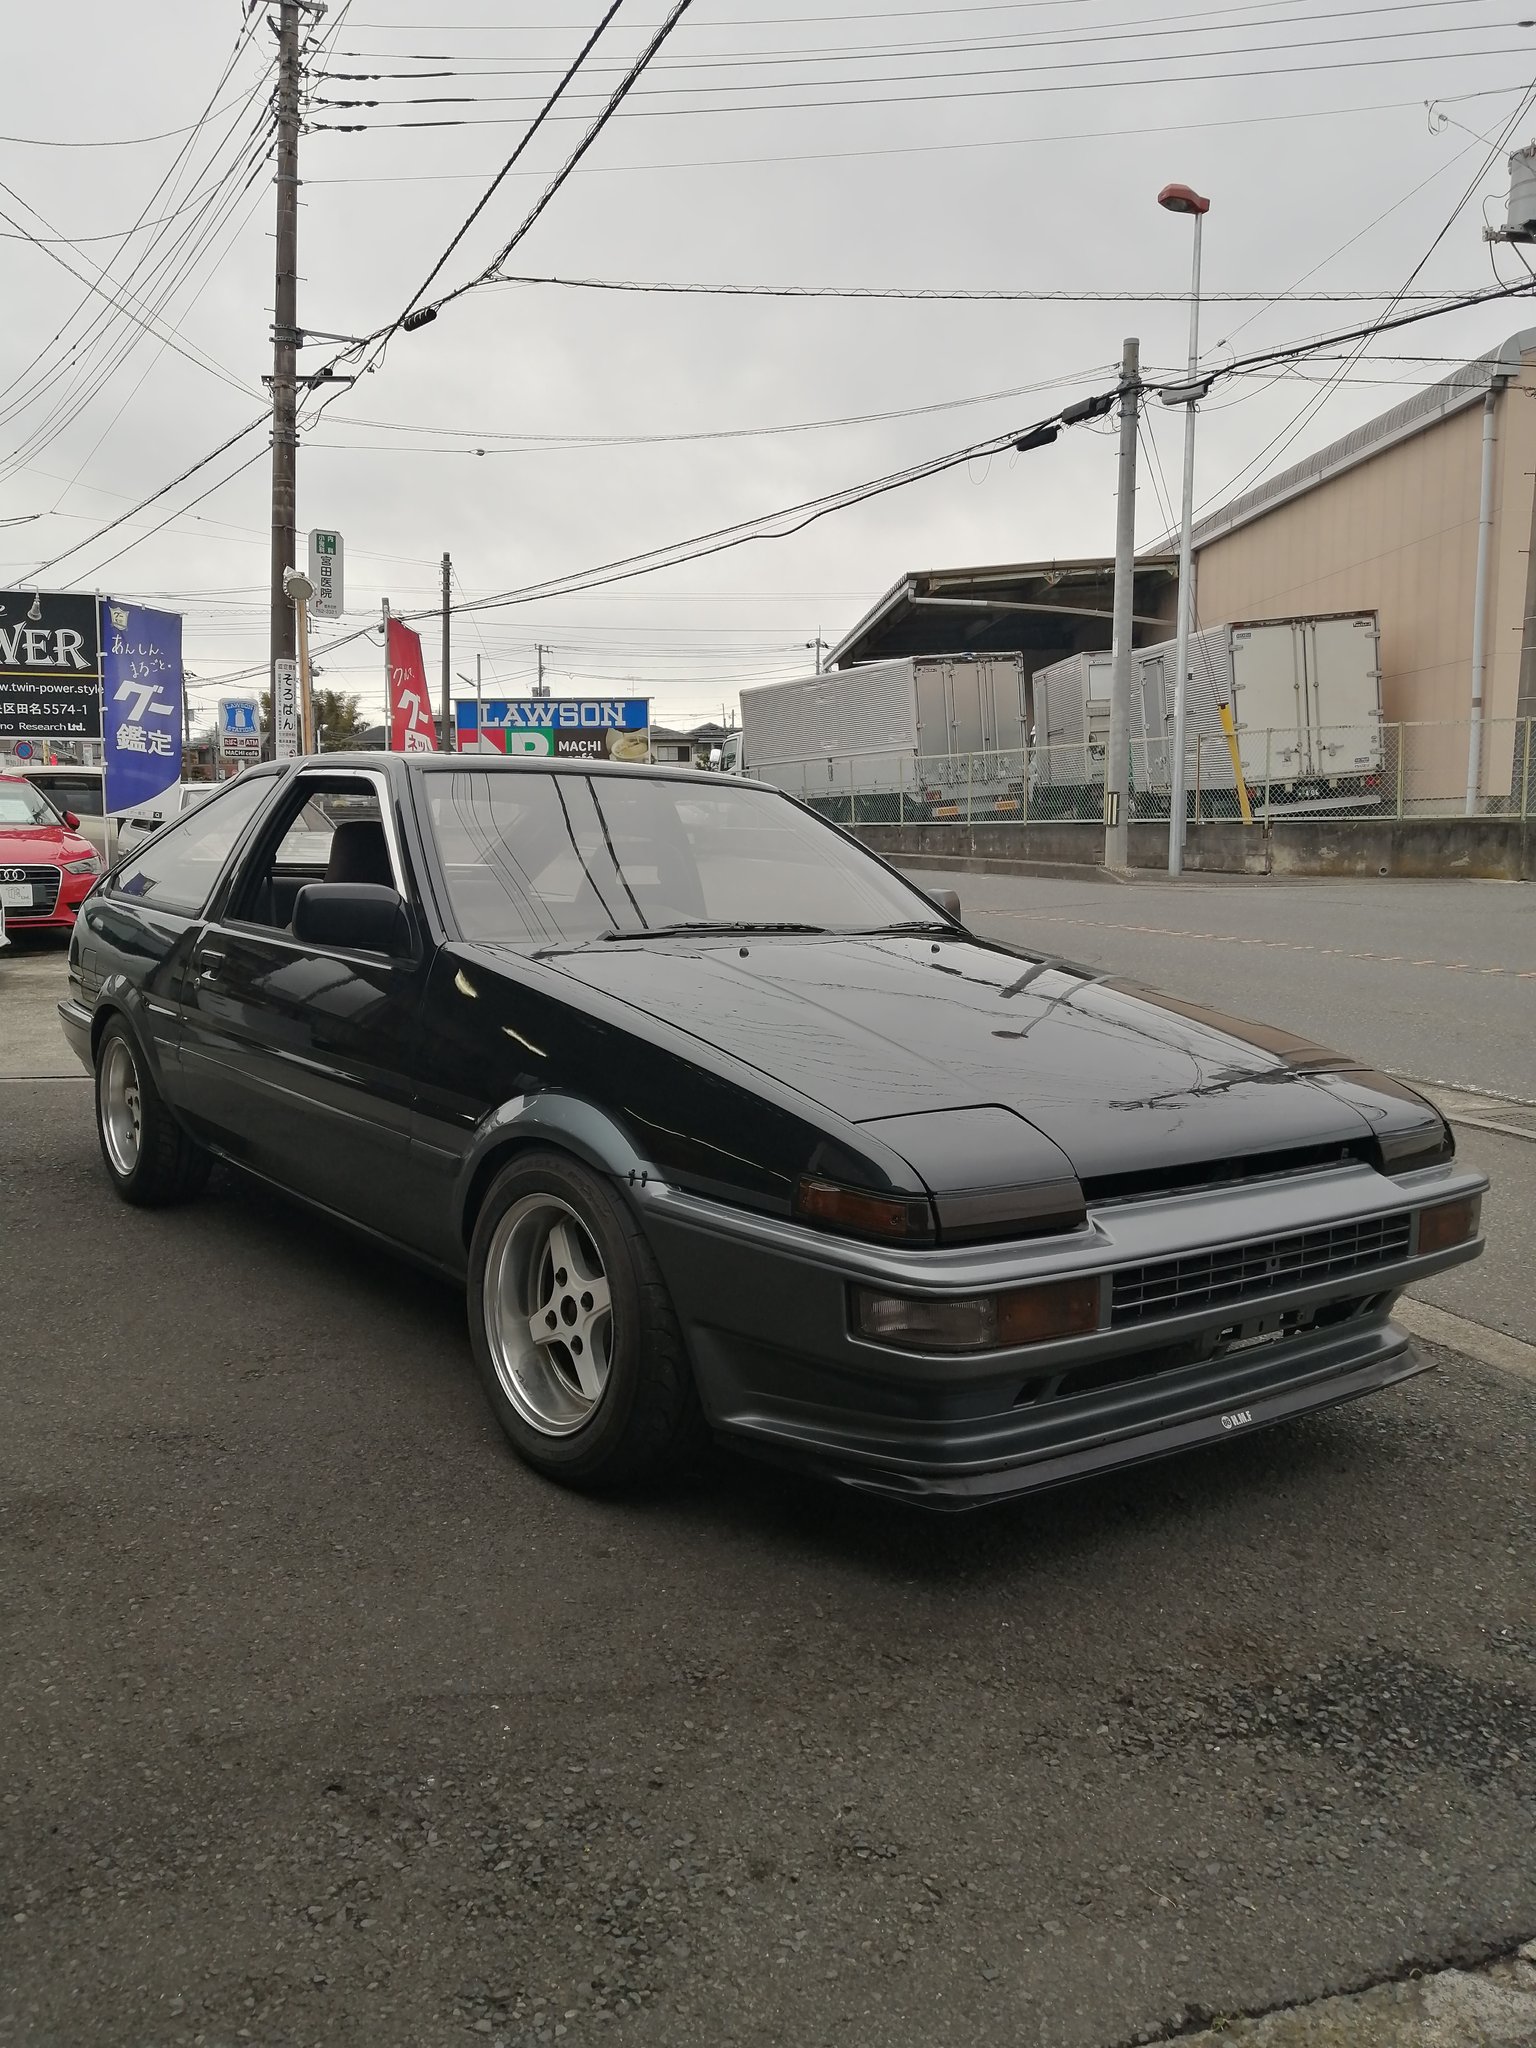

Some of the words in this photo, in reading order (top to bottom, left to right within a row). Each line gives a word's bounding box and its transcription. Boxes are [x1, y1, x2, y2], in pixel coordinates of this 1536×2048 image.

[320, 555, 332, 598] 宮田医院
[113, 680, 174, 721] グー
[283, 673, 293, 730] そろばん
[397, 688, 429, 730] グー
[480, 702, 626, 727] LAWSON
[19, 722, 66, 731] Research
[67, 722, 86, 731] Ltd.
[116, 723, 174, 756] 鑑定
[246, 739, 258, 747] ATM
[558, 740, 601, 752] MACHI
